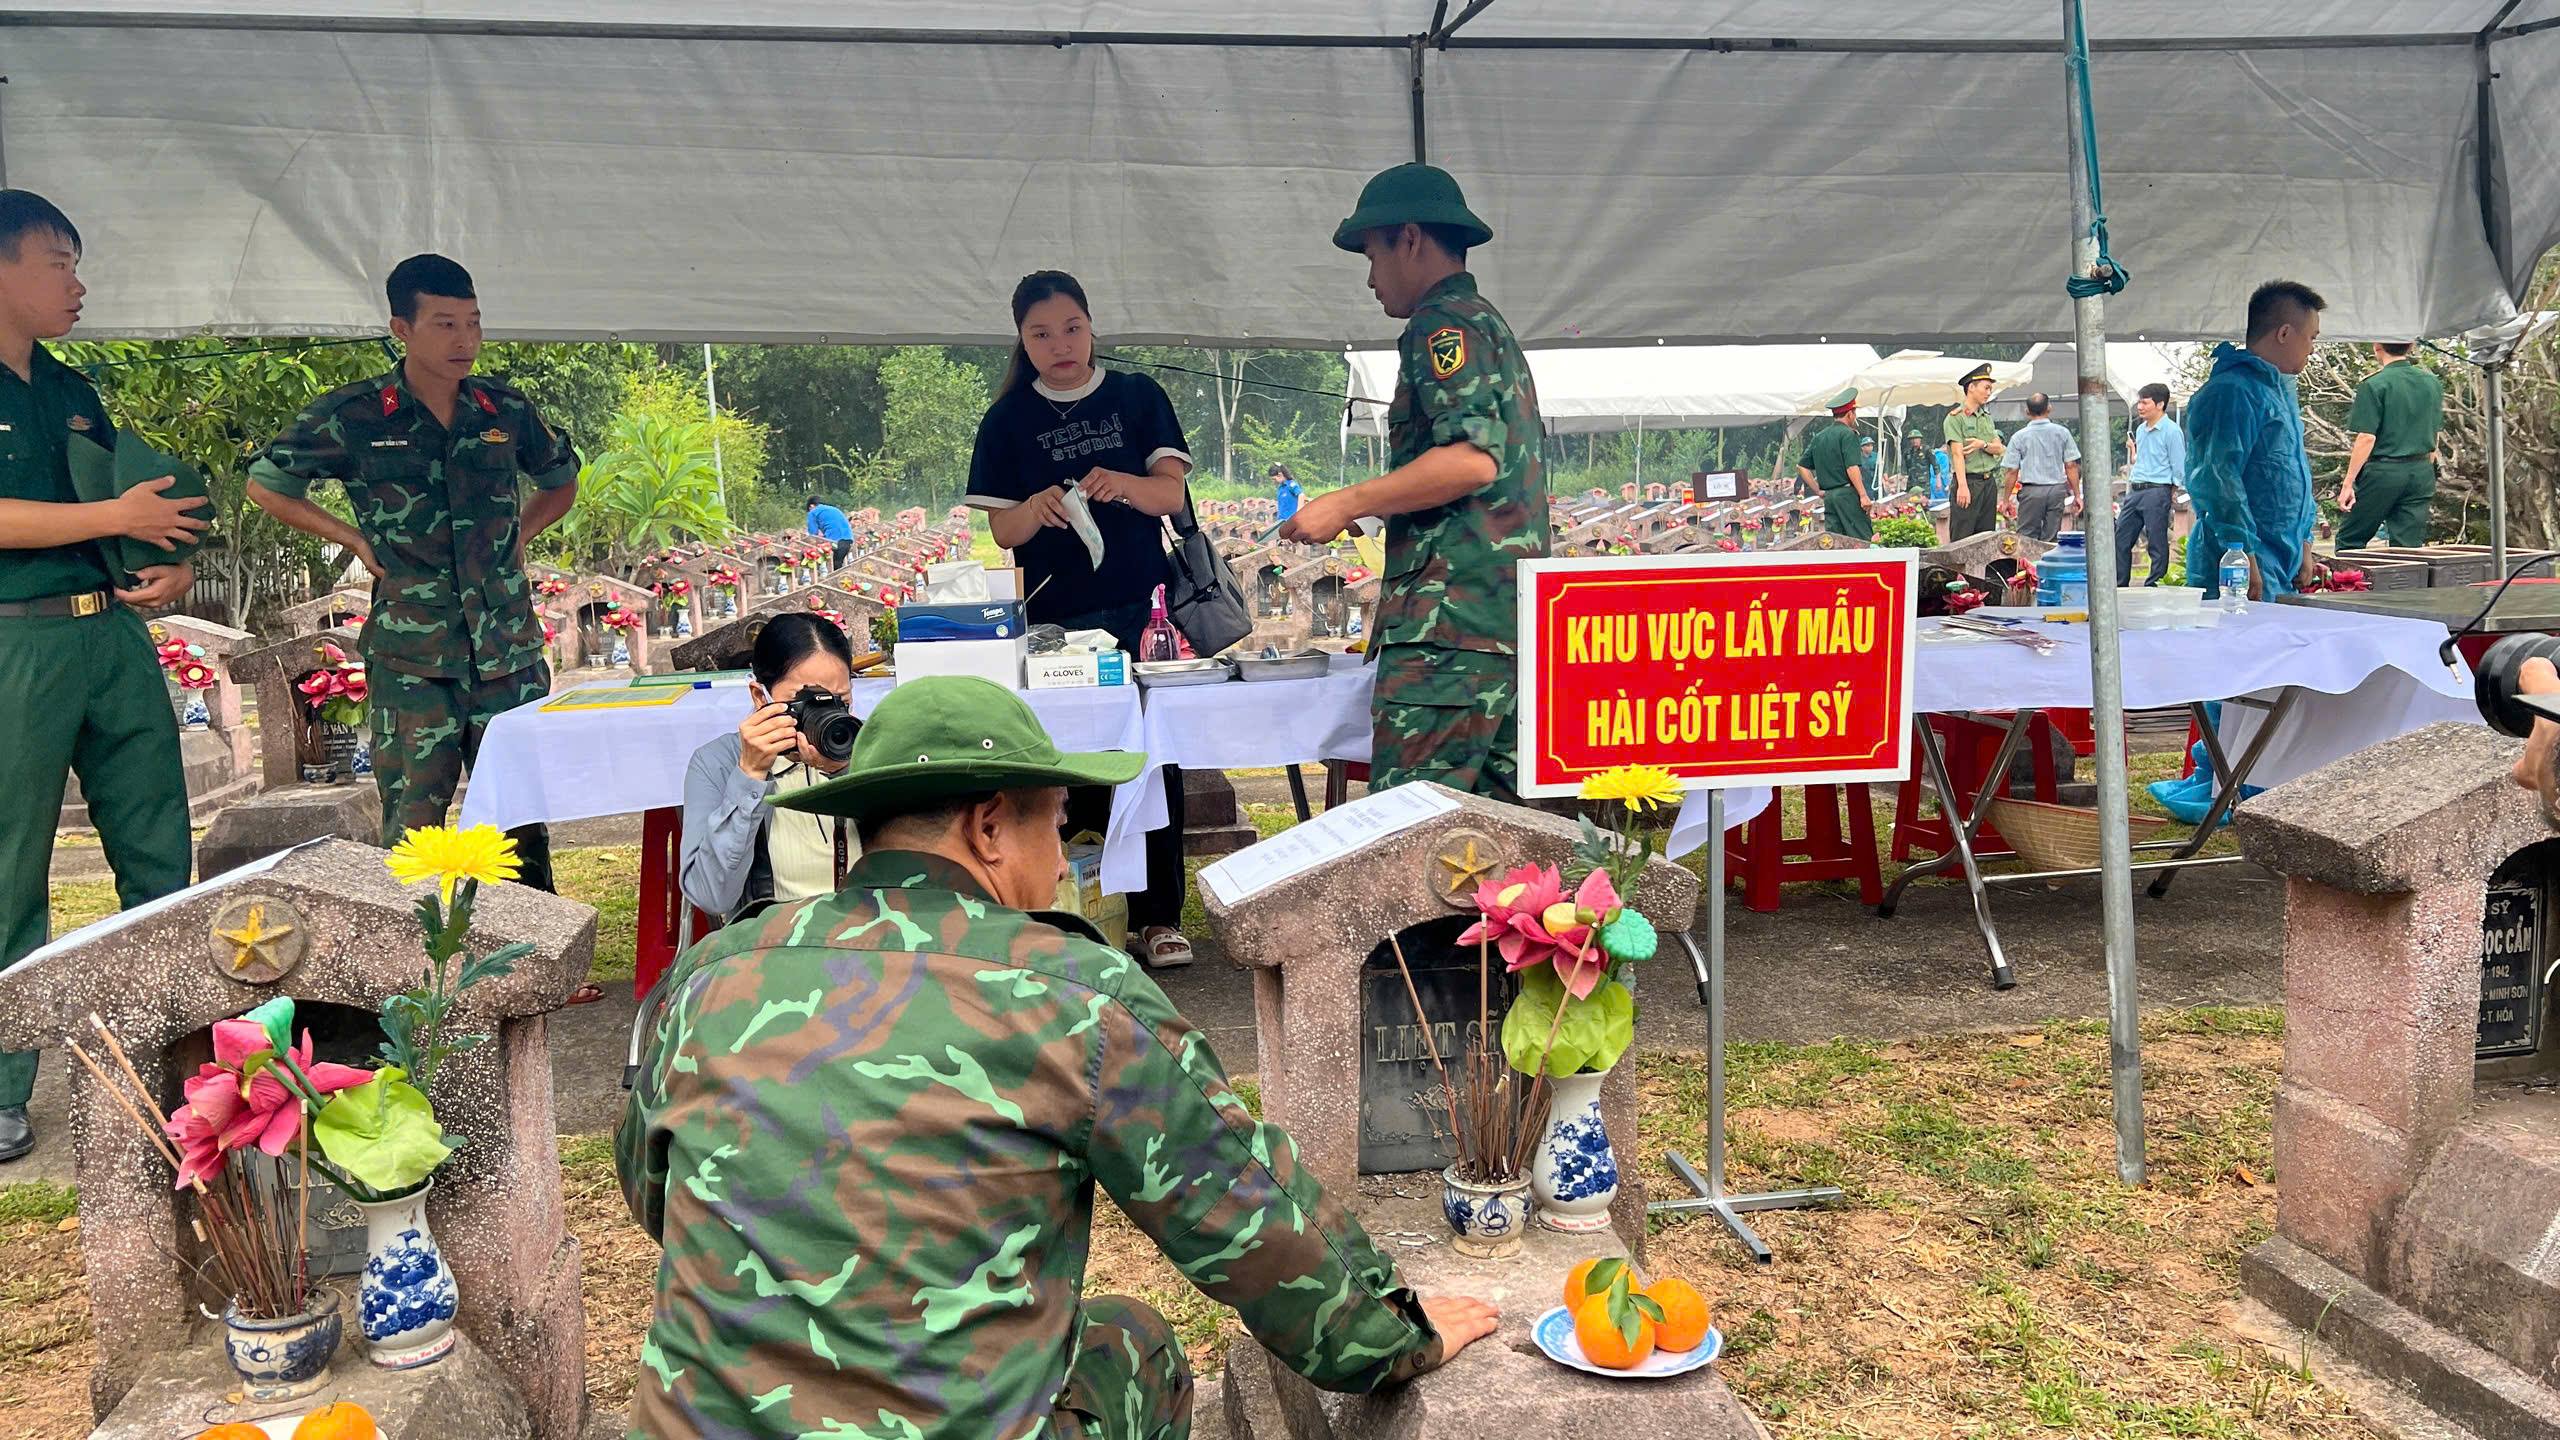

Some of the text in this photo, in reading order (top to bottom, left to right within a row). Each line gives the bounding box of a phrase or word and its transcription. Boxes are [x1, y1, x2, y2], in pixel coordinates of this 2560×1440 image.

[1051, 432, 1124, 461] STUDIO
[1566, 587, 1876, 672] KHU VỰC LẤY MẪU
[1052, 669, 1084, 678] GLOVES
[1587, 678, 1854, 750] HÀI CỐT LIỆT SỸ
[2482, 928, 2504, 962] ỌC
[2492, 964, 2511, 979] 1942
